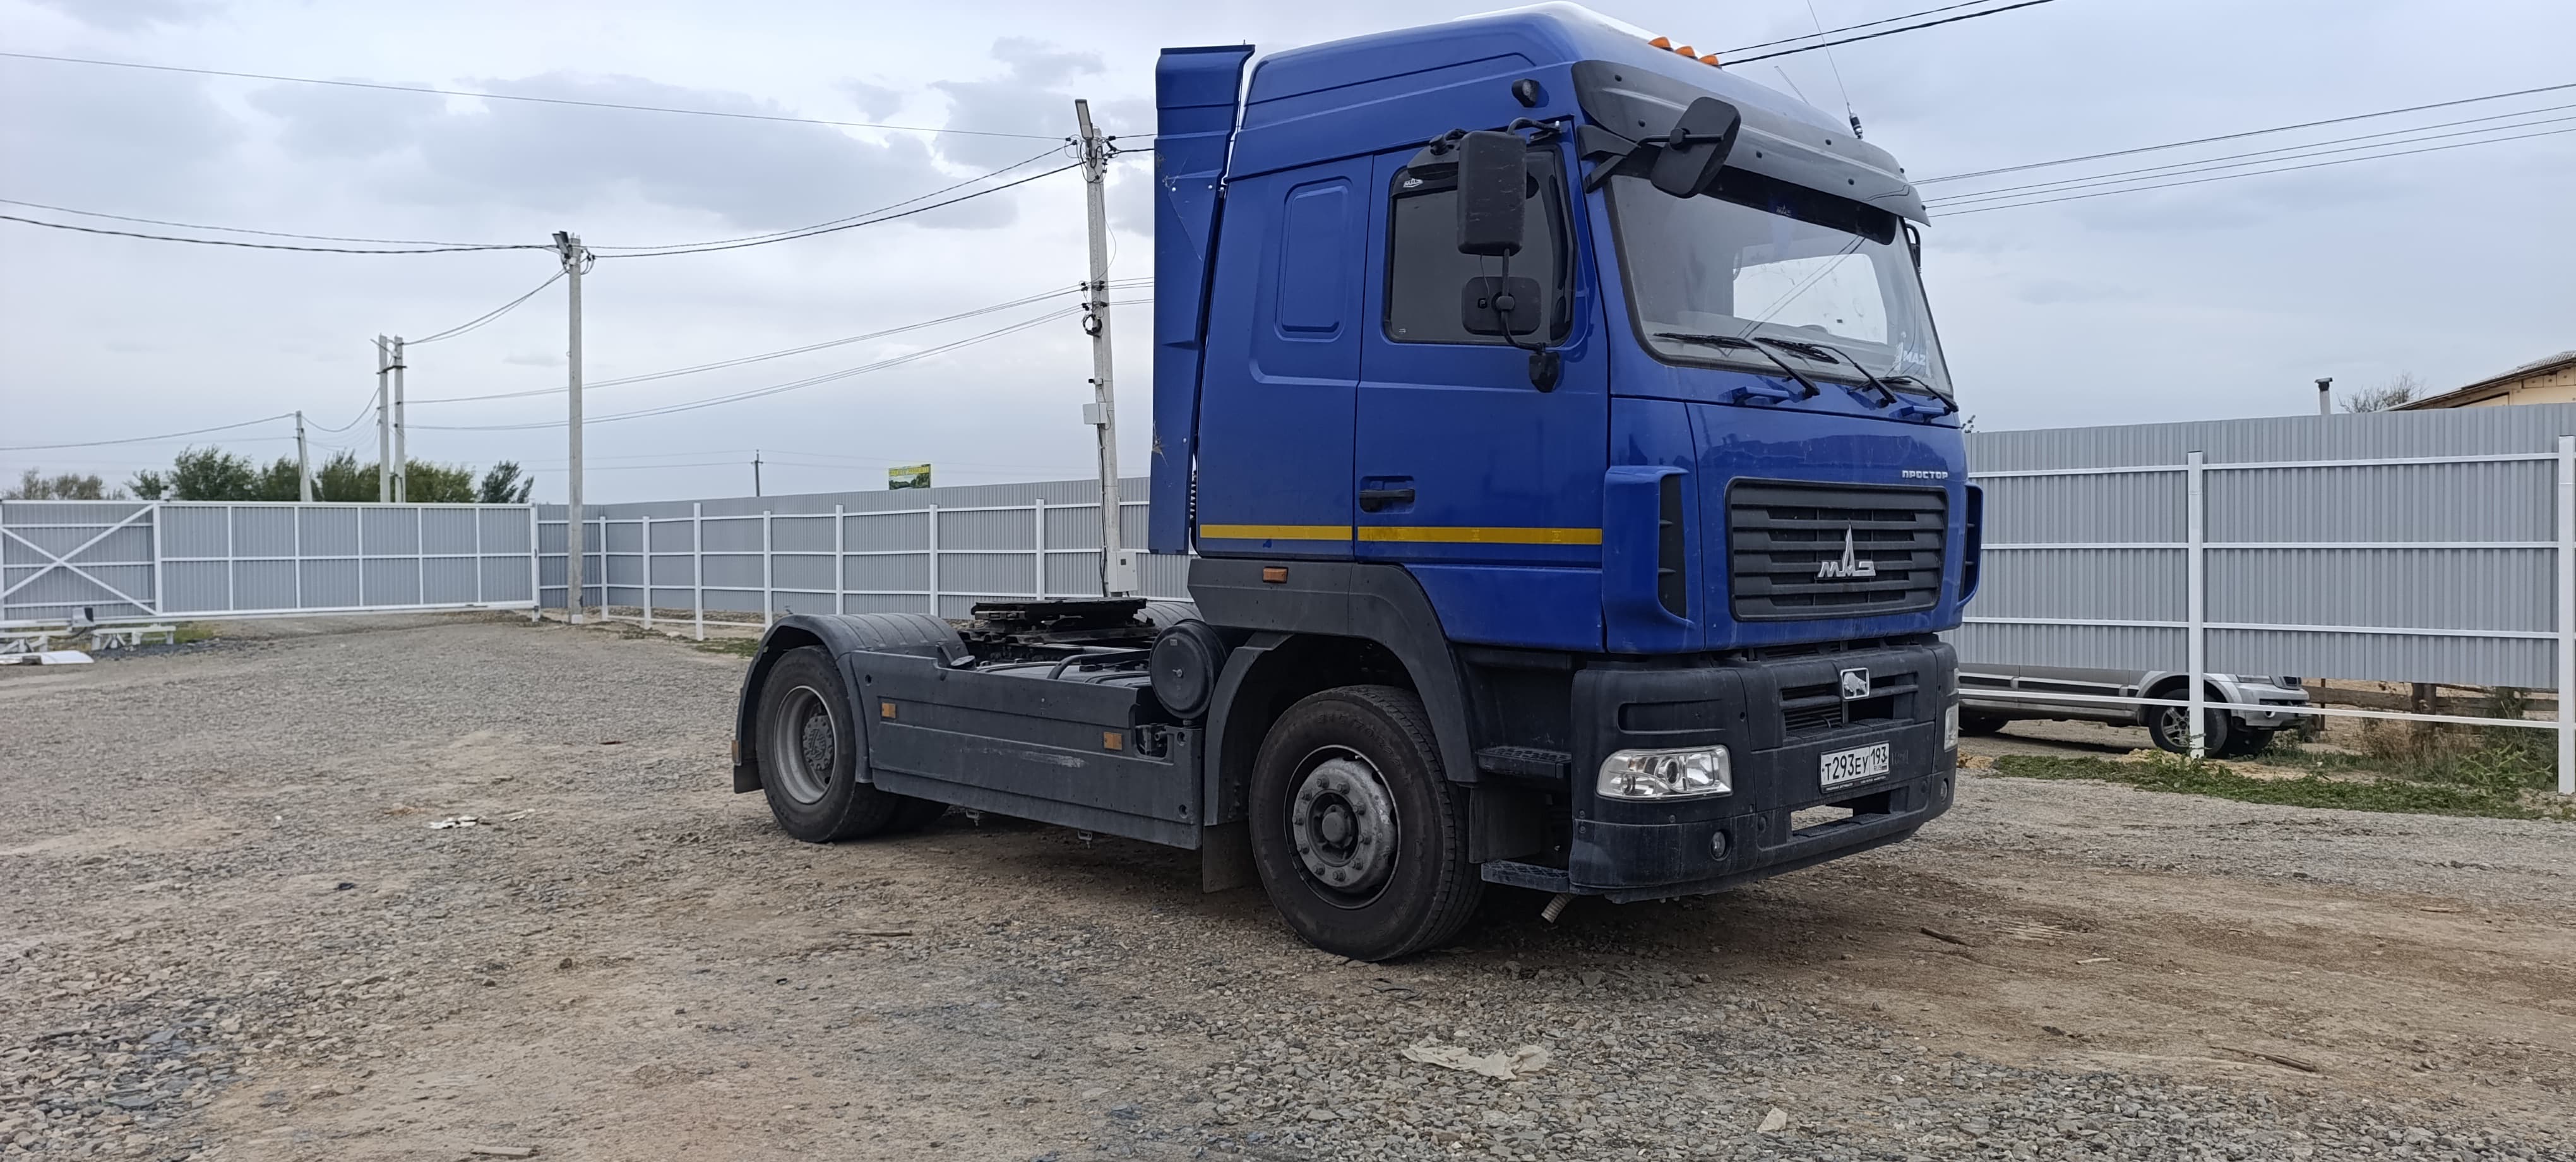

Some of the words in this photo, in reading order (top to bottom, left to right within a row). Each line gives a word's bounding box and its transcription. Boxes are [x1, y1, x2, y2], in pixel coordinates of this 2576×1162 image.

[1901, 469, 1948, 480] ПРОСТОР
[1817, 518, 1876, 578] МАЗ
[1871, 746, 1887, 765] 193
